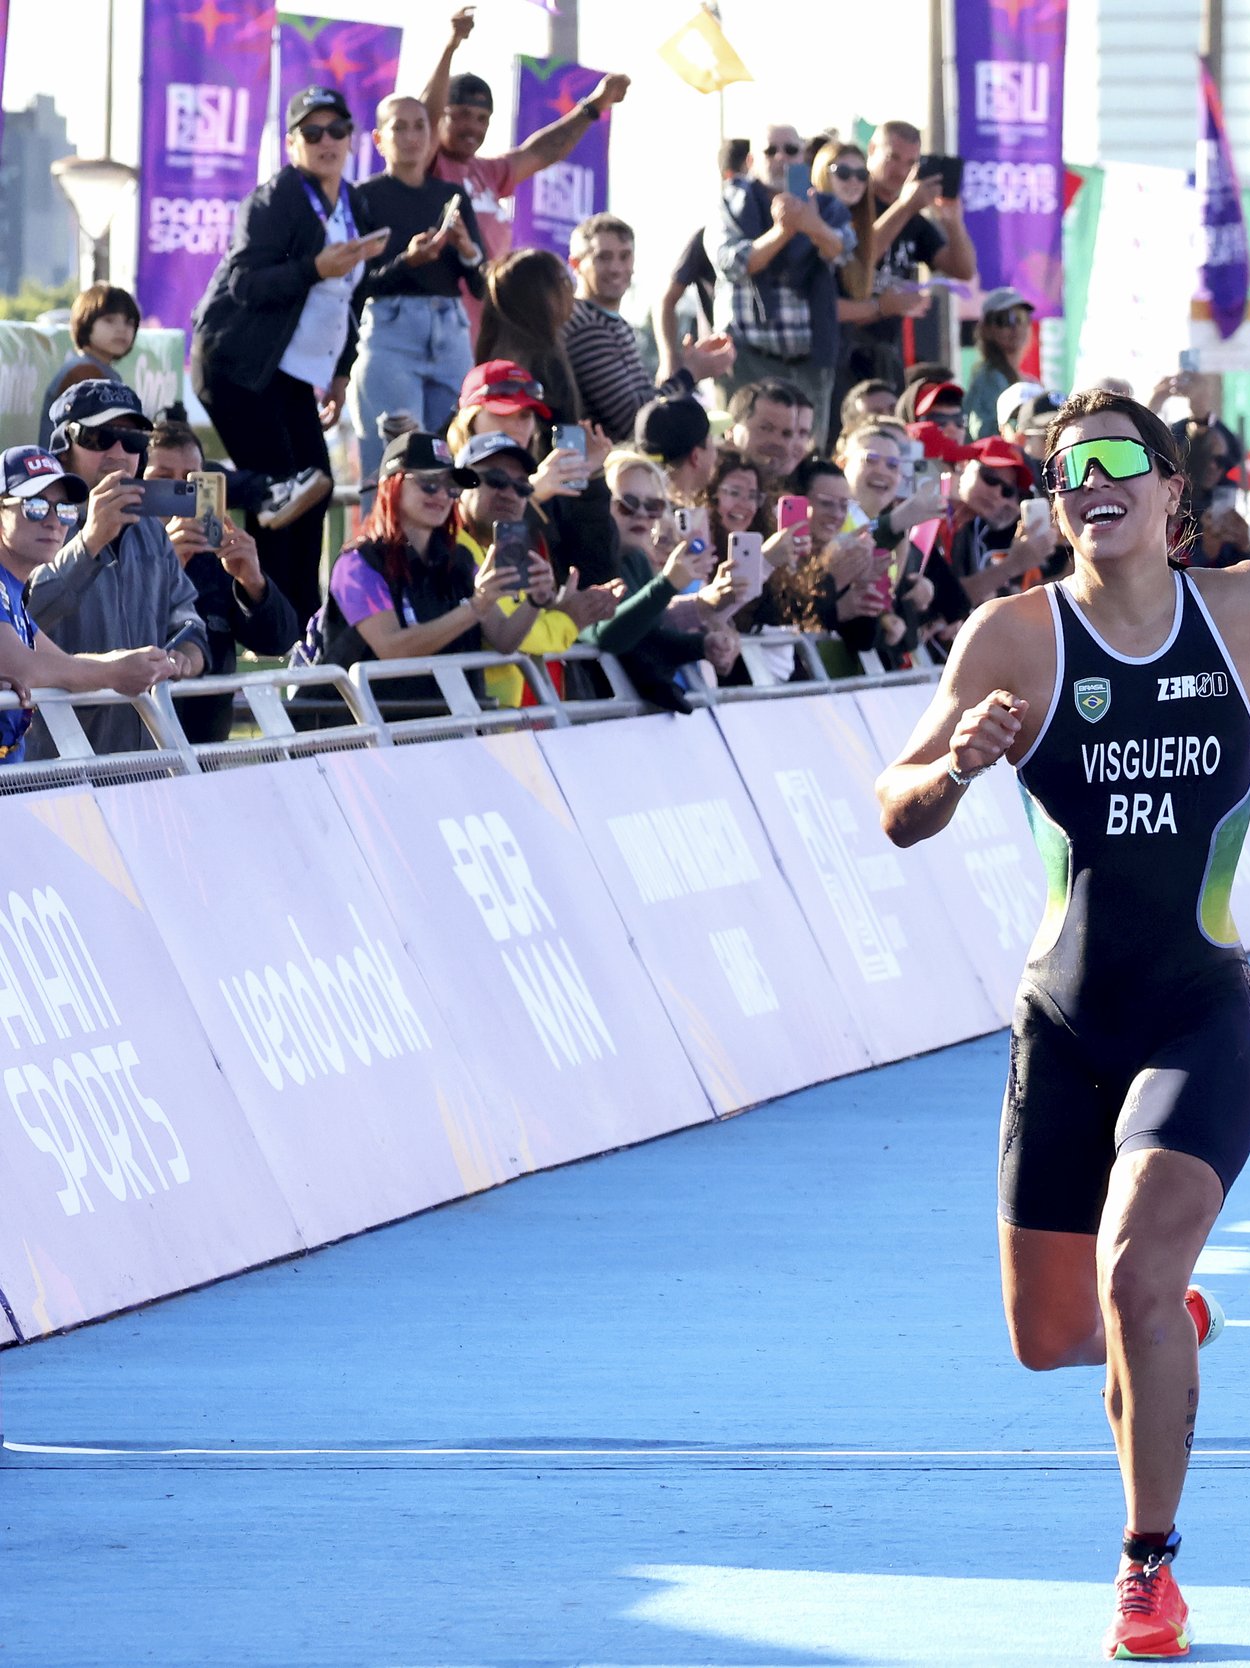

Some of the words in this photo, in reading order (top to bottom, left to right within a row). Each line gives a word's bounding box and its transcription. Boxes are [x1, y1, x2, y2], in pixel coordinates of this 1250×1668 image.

[1078, 684, 1107, 692] BRASIL
[1081, 735, 1221, 784] VISGUEIRO
[1105, 792, 1178, 835] BRA
[437, 811, 557, 942] BOR
[3, 1039, 191, 1217] SPORTS
